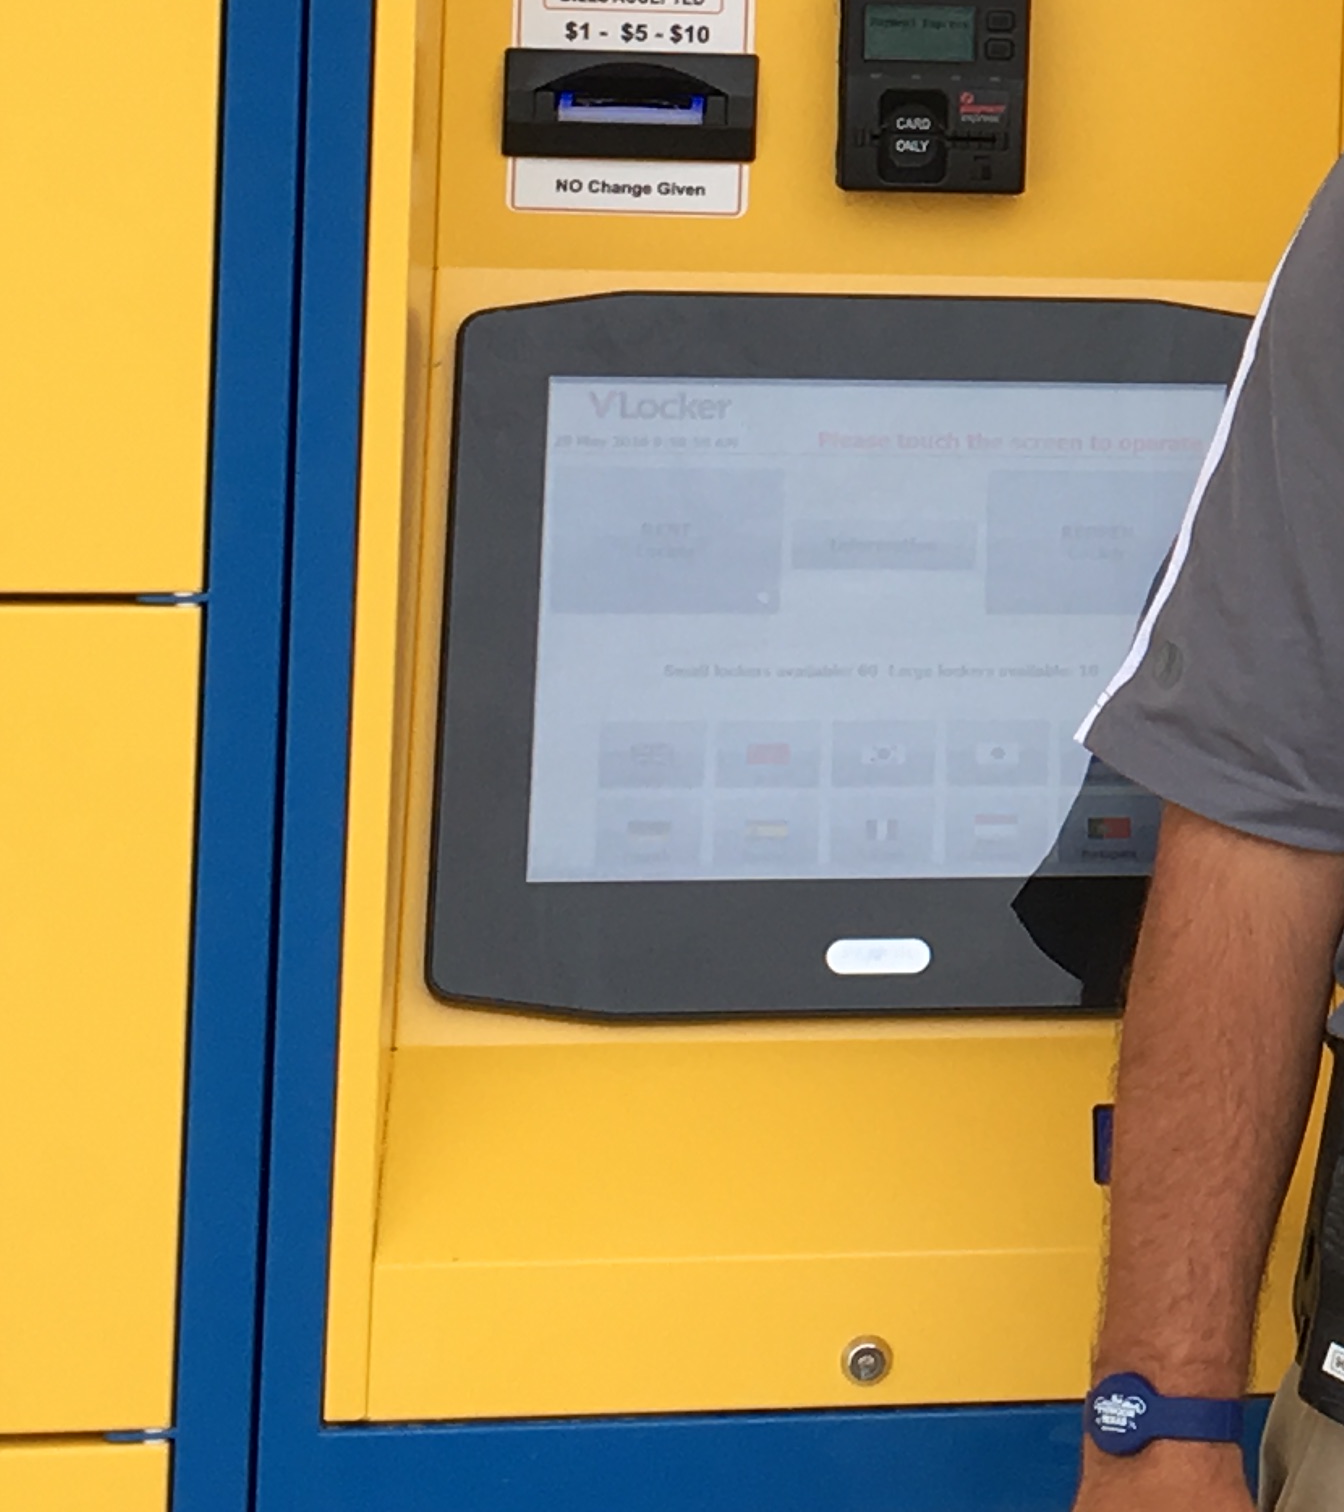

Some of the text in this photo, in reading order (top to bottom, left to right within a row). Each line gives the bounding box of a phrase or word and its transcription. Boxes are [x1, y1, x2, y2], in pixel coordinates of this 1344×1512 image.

[565, 20, 592, 43] $1
[621, 22, 649, 44] $5
[669, 23, 710, 46] $10
[896, 117, 931, 130] CARD
[895, 140, 930, 153] ONLY
[555, 178, 706, 199] NO Change Given
[589, 390, 732, 421] VLocker
[817, 431, 889, 450] Please
[897, 432, 960, 451] touch
[967, 433, 1003, 451] the
[1091, 434, 1112, 452] to
